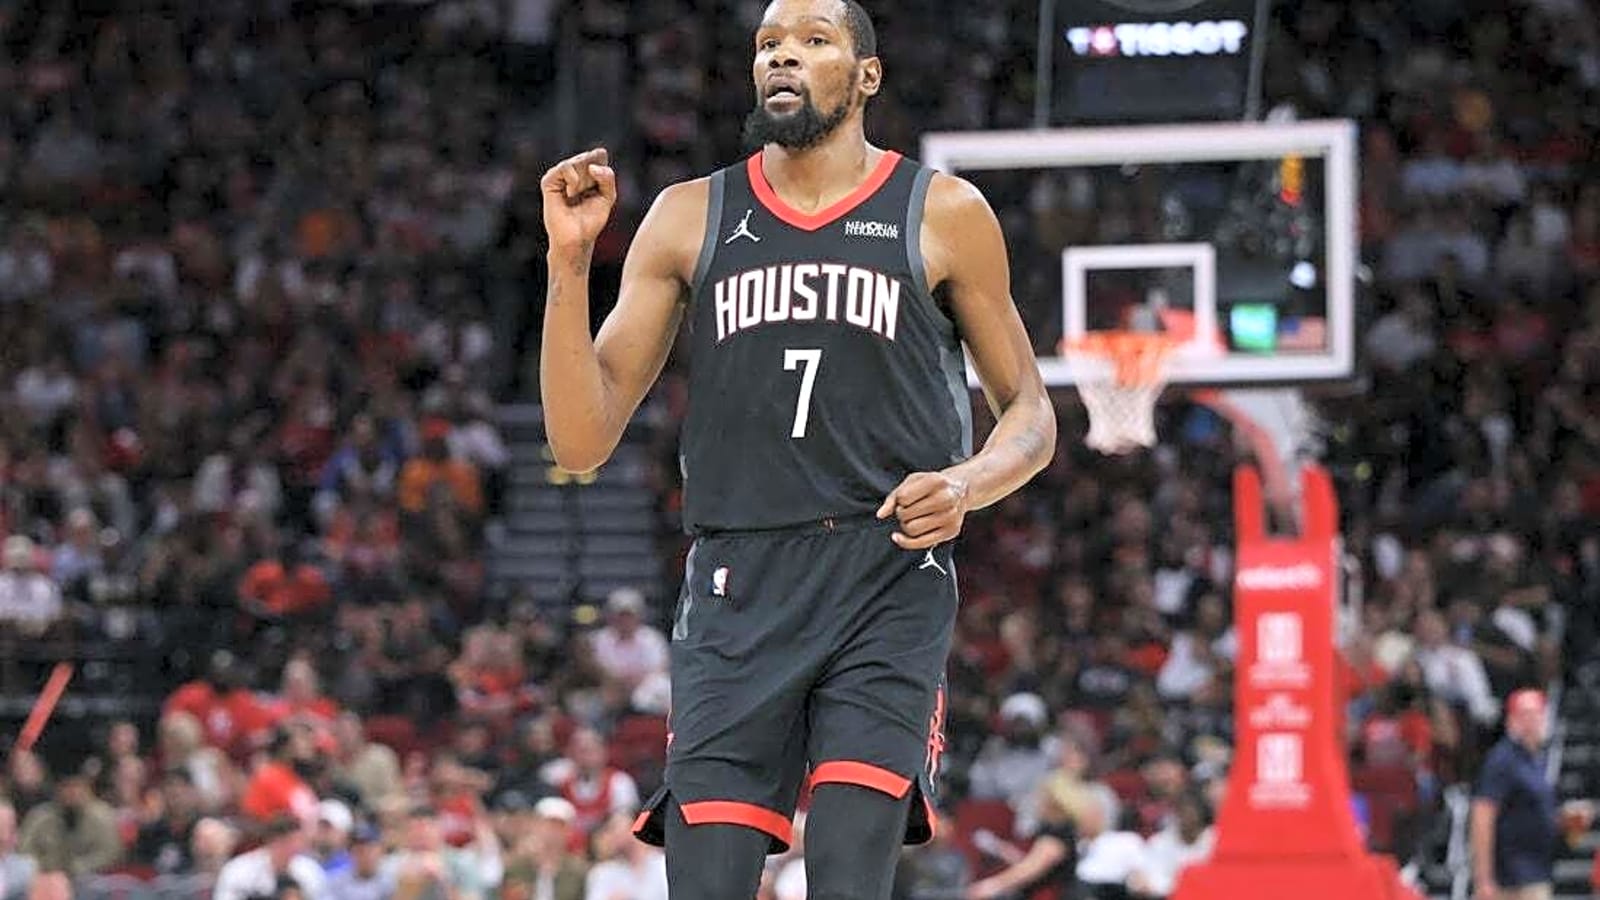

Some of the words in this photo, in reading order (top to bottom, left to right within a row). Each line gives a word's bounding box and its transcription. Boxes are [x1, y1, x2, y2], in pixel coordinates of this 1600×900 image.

[1114, 20, 1247, 56] TISSOT
[714, 262, 901, 342] HOUSTON
[783, 348, 822, 438] 7
